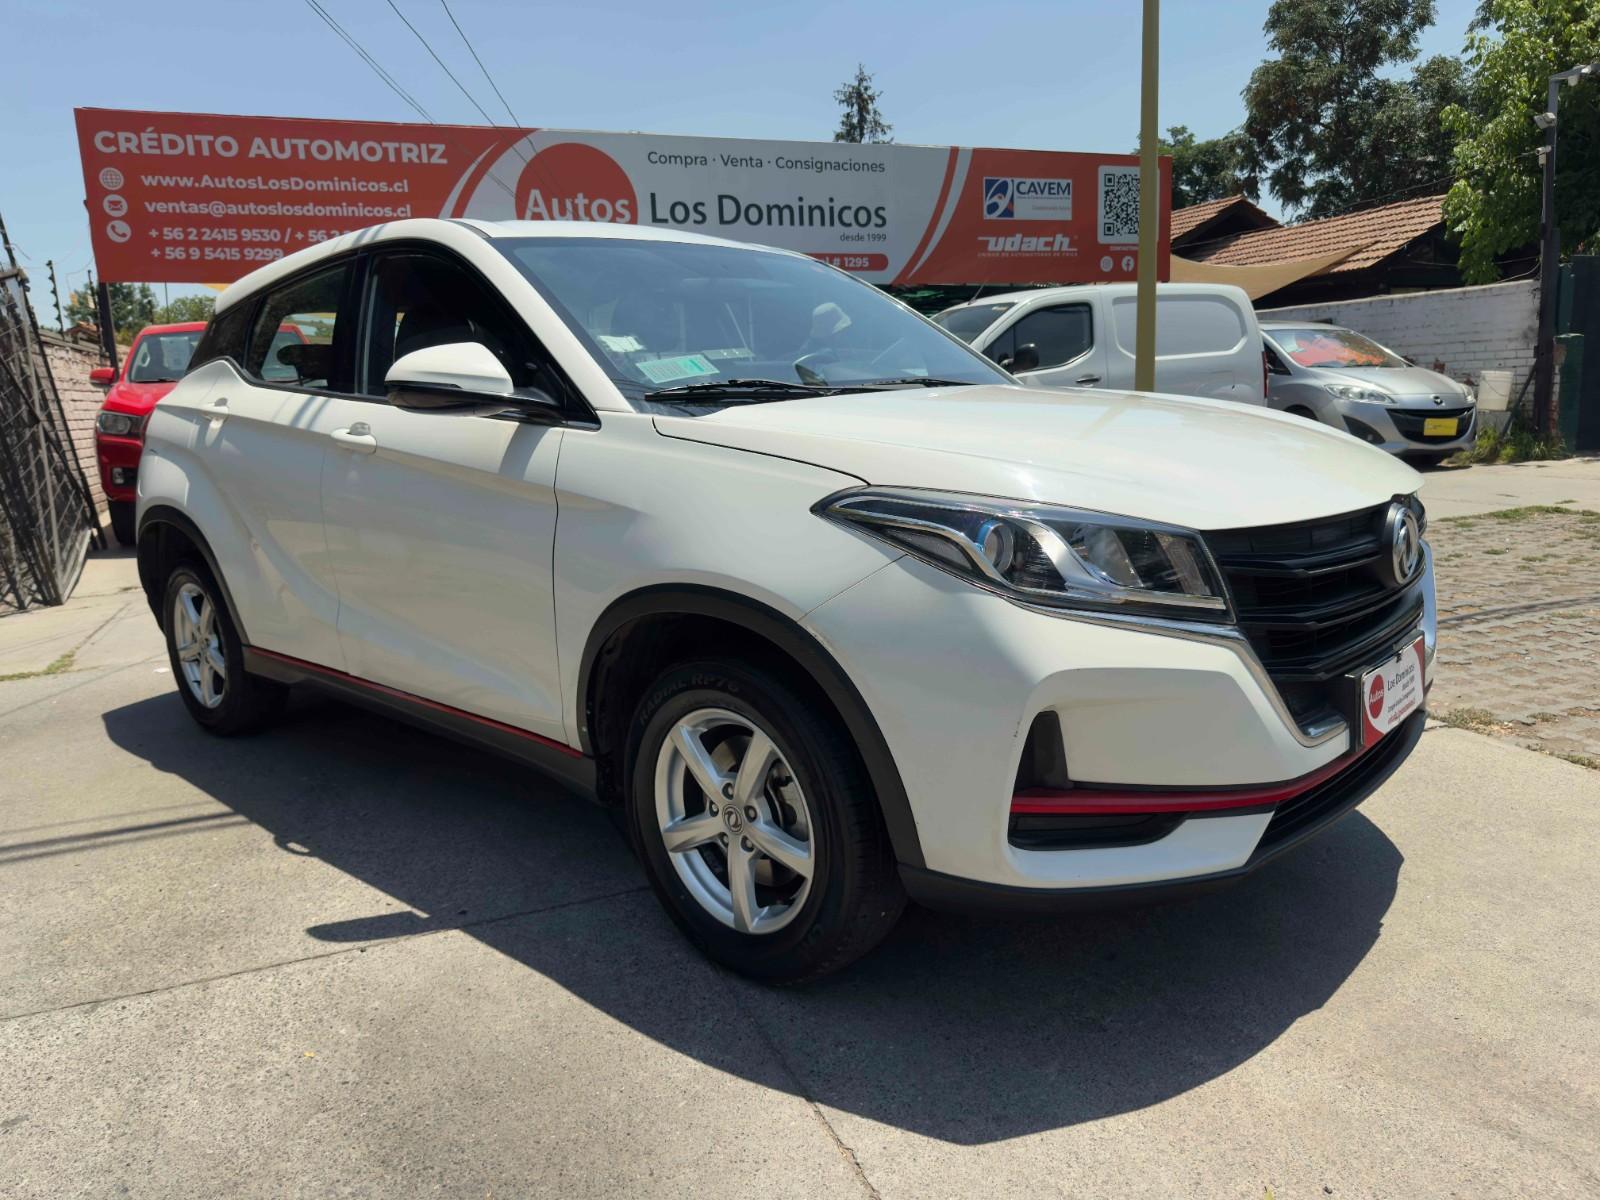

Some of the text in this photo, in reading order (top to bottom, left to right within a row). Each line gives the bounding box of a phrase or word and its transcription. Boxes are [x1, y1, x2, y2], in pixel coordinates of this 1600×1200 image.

[94, 127, 448, 165] CRÉDITO AUTOMOTRIZ
[647, 151, 886, 173] Compra Venta Consignaciones
[140, 174, 409, 193] www.AutosLosDominicos.cl
[1015, 181, 1071, 196] CAVEM
[144, 200, 412, 218] ventas@autoslosdominicos.cl
[524, 188, 887, 228] Autos Los Dominicos
[163, 227, 184, 240] 56
[187, 228, 198, 240] 2
[201, 228, 238, 241] 2415
[241, 228, 281, 242] 9530
[308, 229, 328, 242] 56
[840, 233, 887, 242] desde 1999
[165, 247, 186, 260] 56
[189, 248, 200, 260] 9
[204, 248, 241, 260] 5415
[244, 248, 284, 261] 9299
[844, 256, 870, 268] 1295
